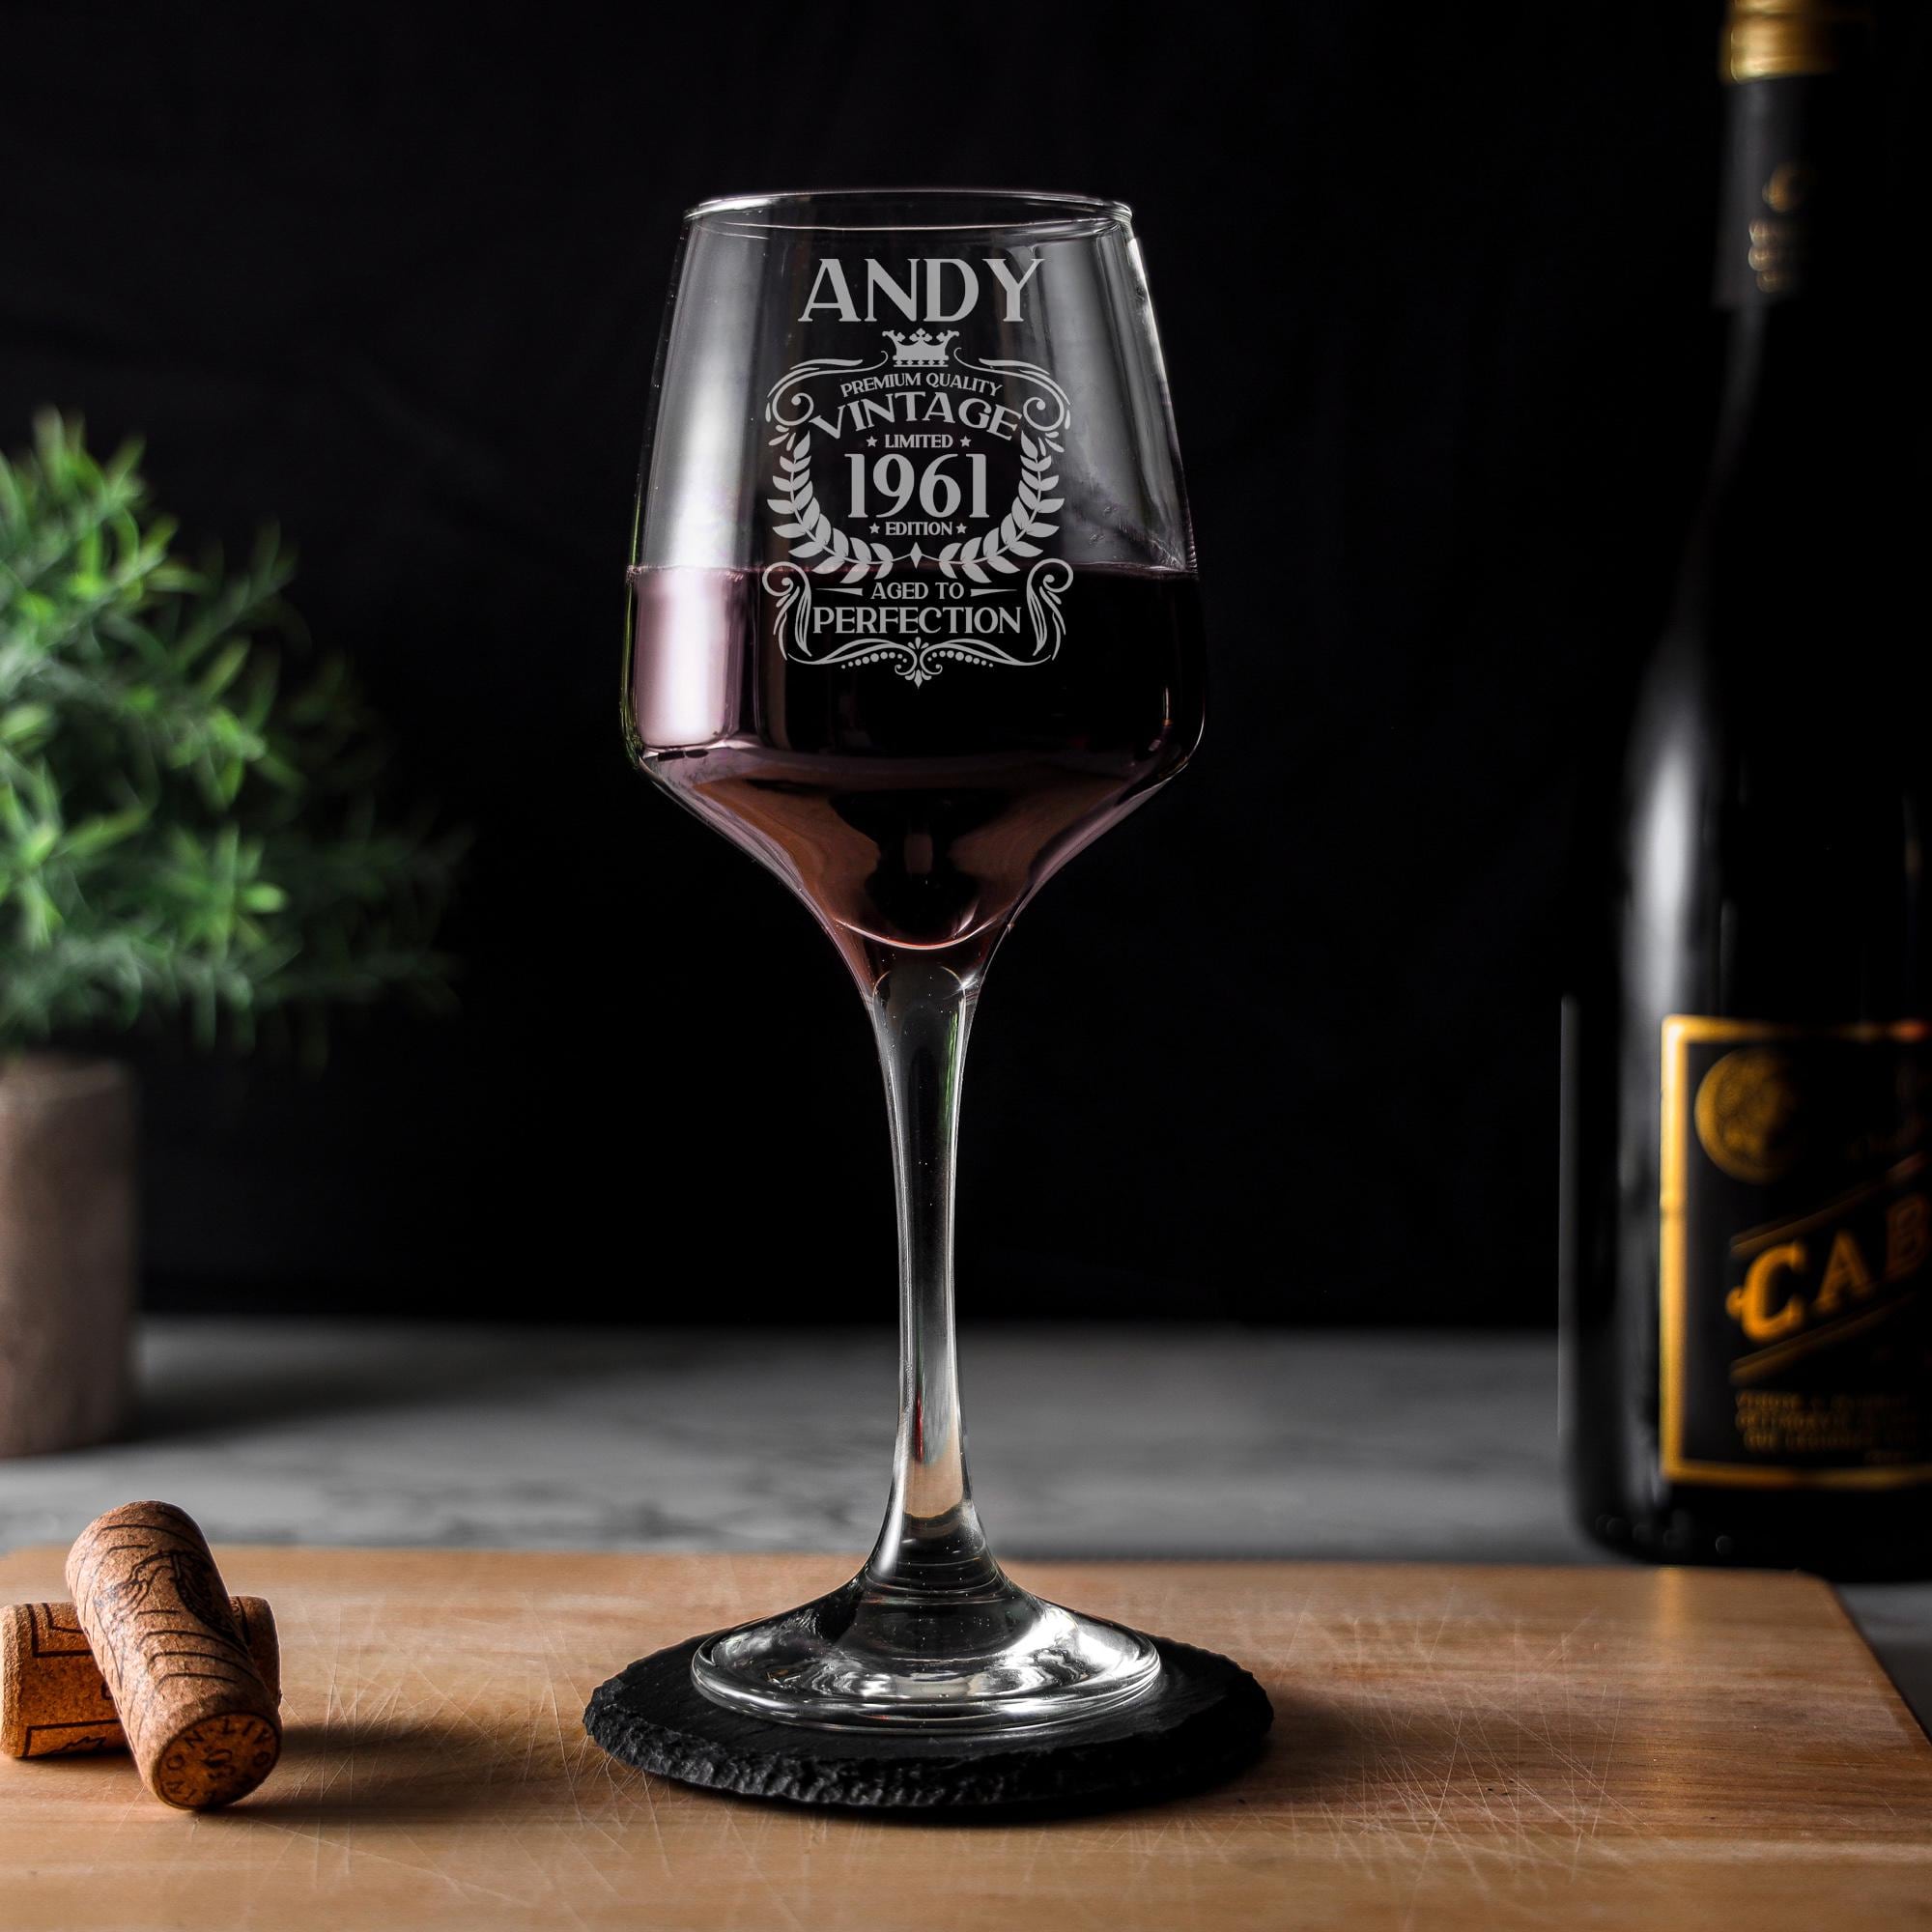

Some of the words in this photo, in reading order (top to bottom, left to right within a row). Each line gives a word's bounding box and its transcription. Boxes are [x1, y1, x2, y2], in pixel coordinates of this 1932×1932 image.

[797, 257, 1045, 323] ANDY
[839, 373, 923, 398] PREMIUM
[925, 373, 1003, 397] QUALITY
[809, 391, 1023, 440] VINTAGE
[885, 434, 953, 449] LIMITED
[844, 453, 990, 519] 1961
[885, 521, 953, 536] EDITION
[870, 582, 929, 600] AGED
[934, 582, 965, 600] TO
[812, 606, 1022, 634] PERFECTION
